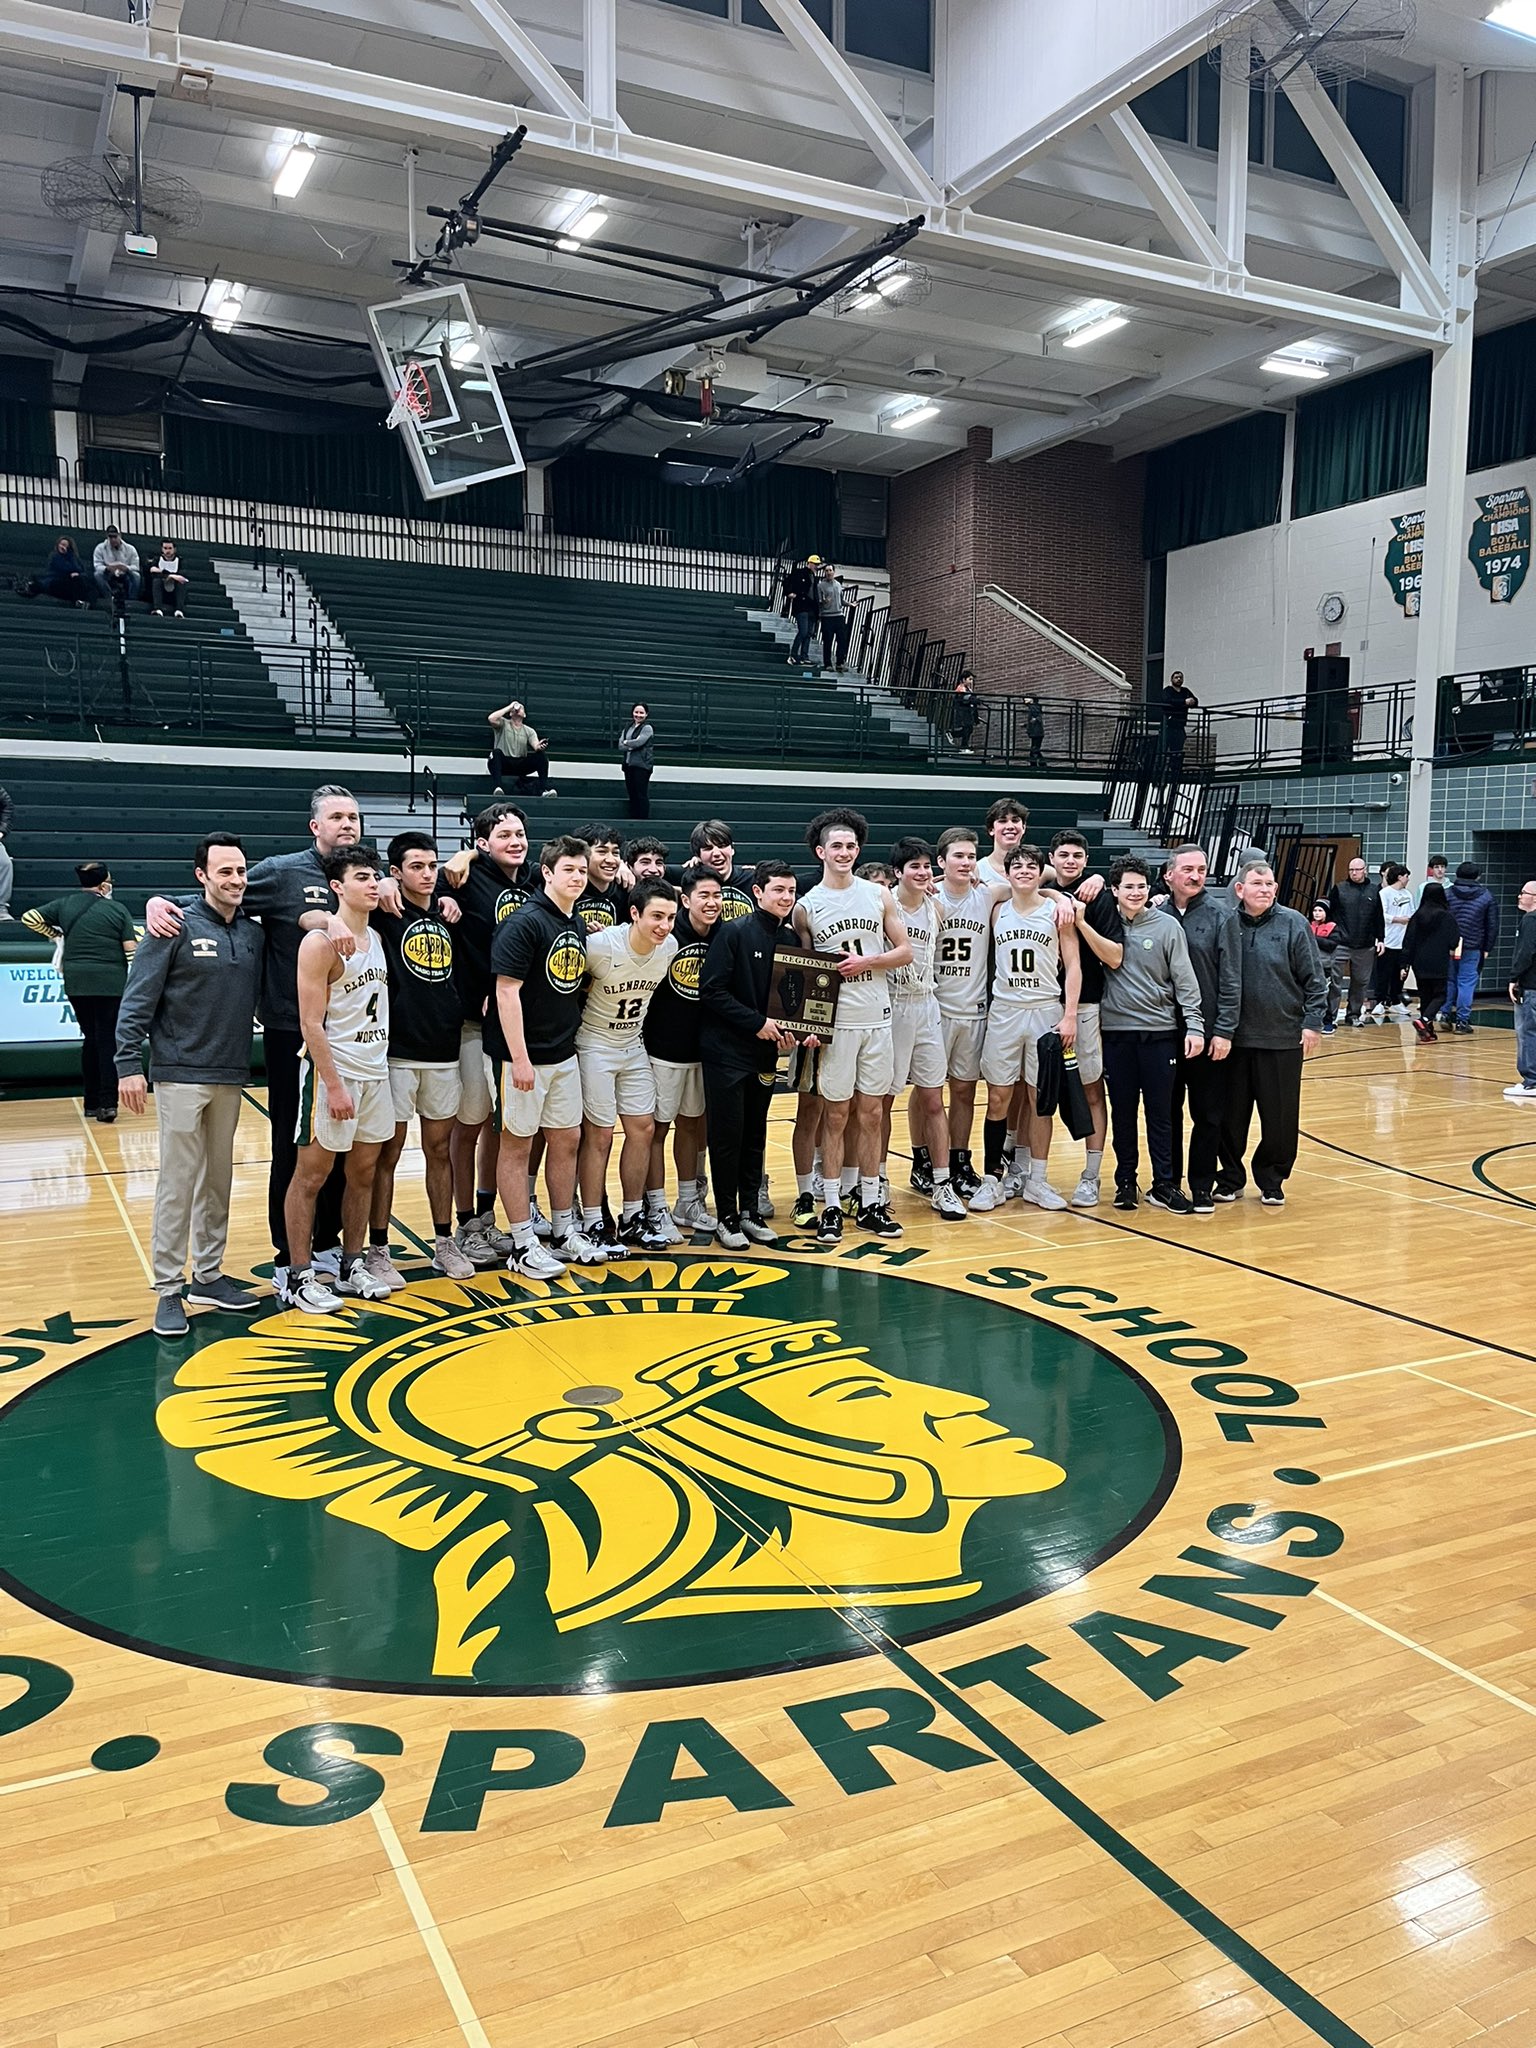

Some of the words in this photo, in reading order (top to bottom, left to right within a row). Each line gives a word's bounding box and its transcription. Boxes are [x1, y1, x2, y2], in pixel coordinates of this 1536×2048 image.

[1485, 489, 1525, 508] Spartan
[1482, 506, 1530, 522] CHAMPIONS
[1493, 501, 1519, 513] STATE
[1396, 530, 1425, 542] CHAMP
[1406, 524, 1425, 533] STAT
[1490, 533, 1517, 546] BOYS
[1479, 540, 1529, 557] BASEBALL
[1404, 553, 1423, 564] BOY
[1485, 555, 1521, 575] 1974
[1393, 562, 1423, 574] BASEB
[1399, 575, 1422, 591] 196
[816, 918, 880, 943] GLENBROOK
[996, 929, 1052, 947] GLENBROOK
[841, 938, 863, 956] 11
[942, 937, 971, 961] 25
[782, 955, 835, 969] REGIONAL
[1010, 948, 1035, 973] 10
[10, 968, 63, 981] WELC
[939, 965, 971, 977] NORTH
[603, 980, 658, 995] GLENBROO
[1008, 978, 1040, 988] NORTH
[366, 993, 379, 1023] 4
[615, 998, 643, 1019] 12
[776, 1020, 830, 1034] AMPIONS
[354, 1028, 387, 1044] NORTH
[965, 1265, 1328, 1443] SCHOOL
[224, 1502, 1345, 1832] SPARTANS
